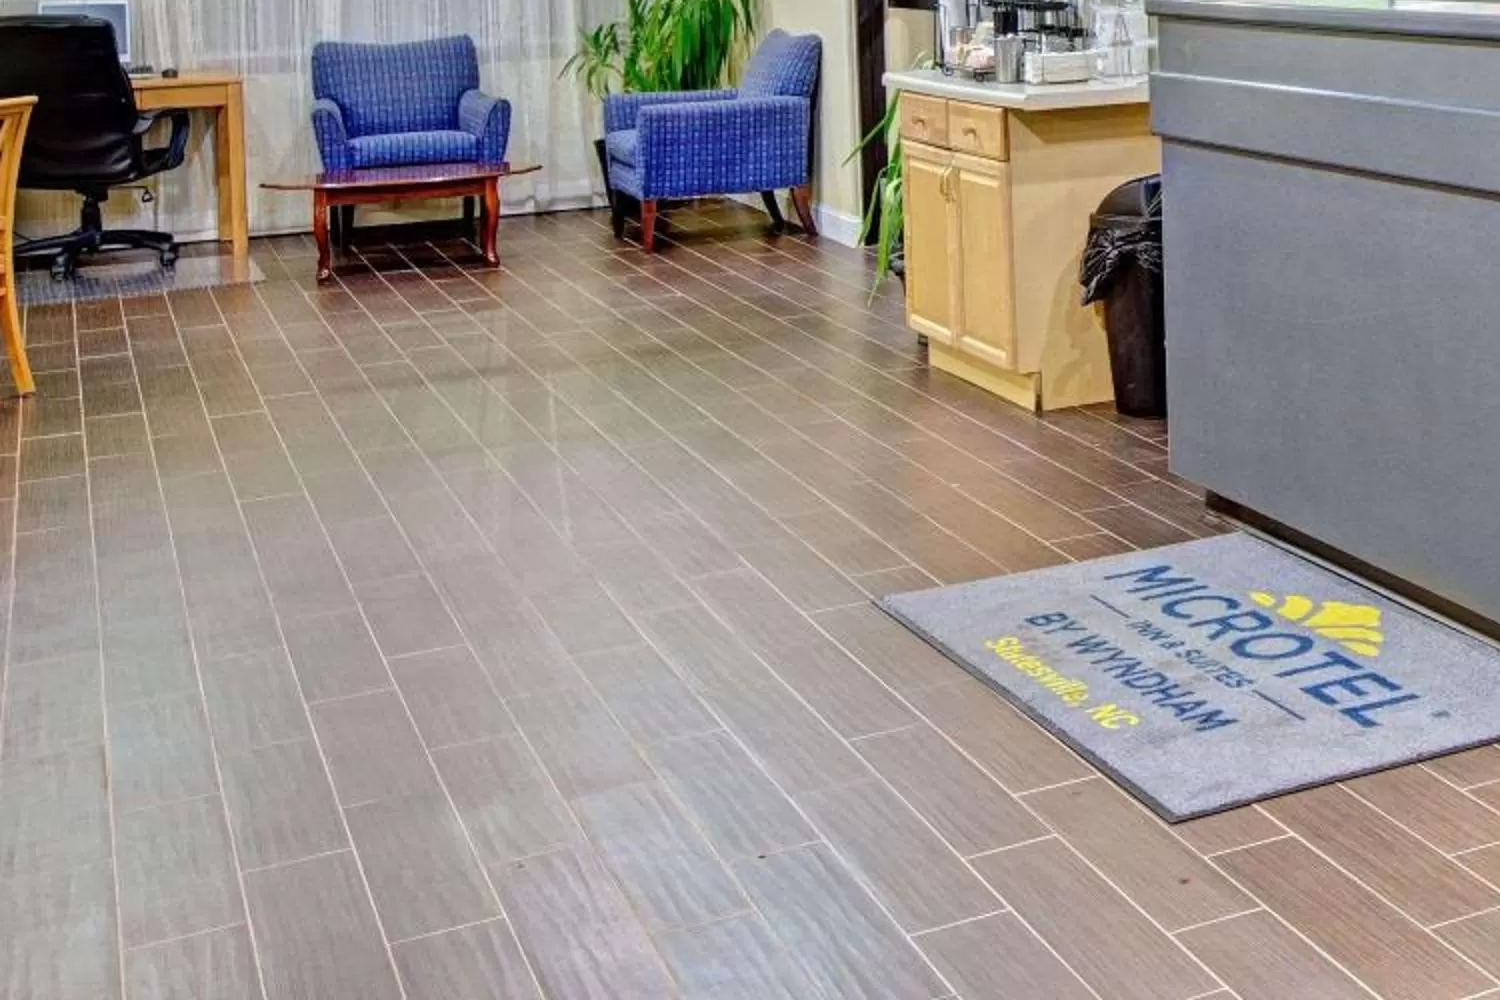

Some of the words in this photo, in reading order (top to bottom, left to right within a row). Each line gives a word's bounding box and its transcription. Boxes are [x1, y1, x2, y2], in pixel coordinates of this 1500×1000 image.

[1025, 611, 1088, 634] BY
[1066, 634, 1241, 732] WYNDHAM
[1104, 565, 1421, 729] MICROTEL
[1126, 618, 1173, 642] INN
[1175, 648, 1254, 689] SUITES
[1086, 703, 1141, 730] NC
